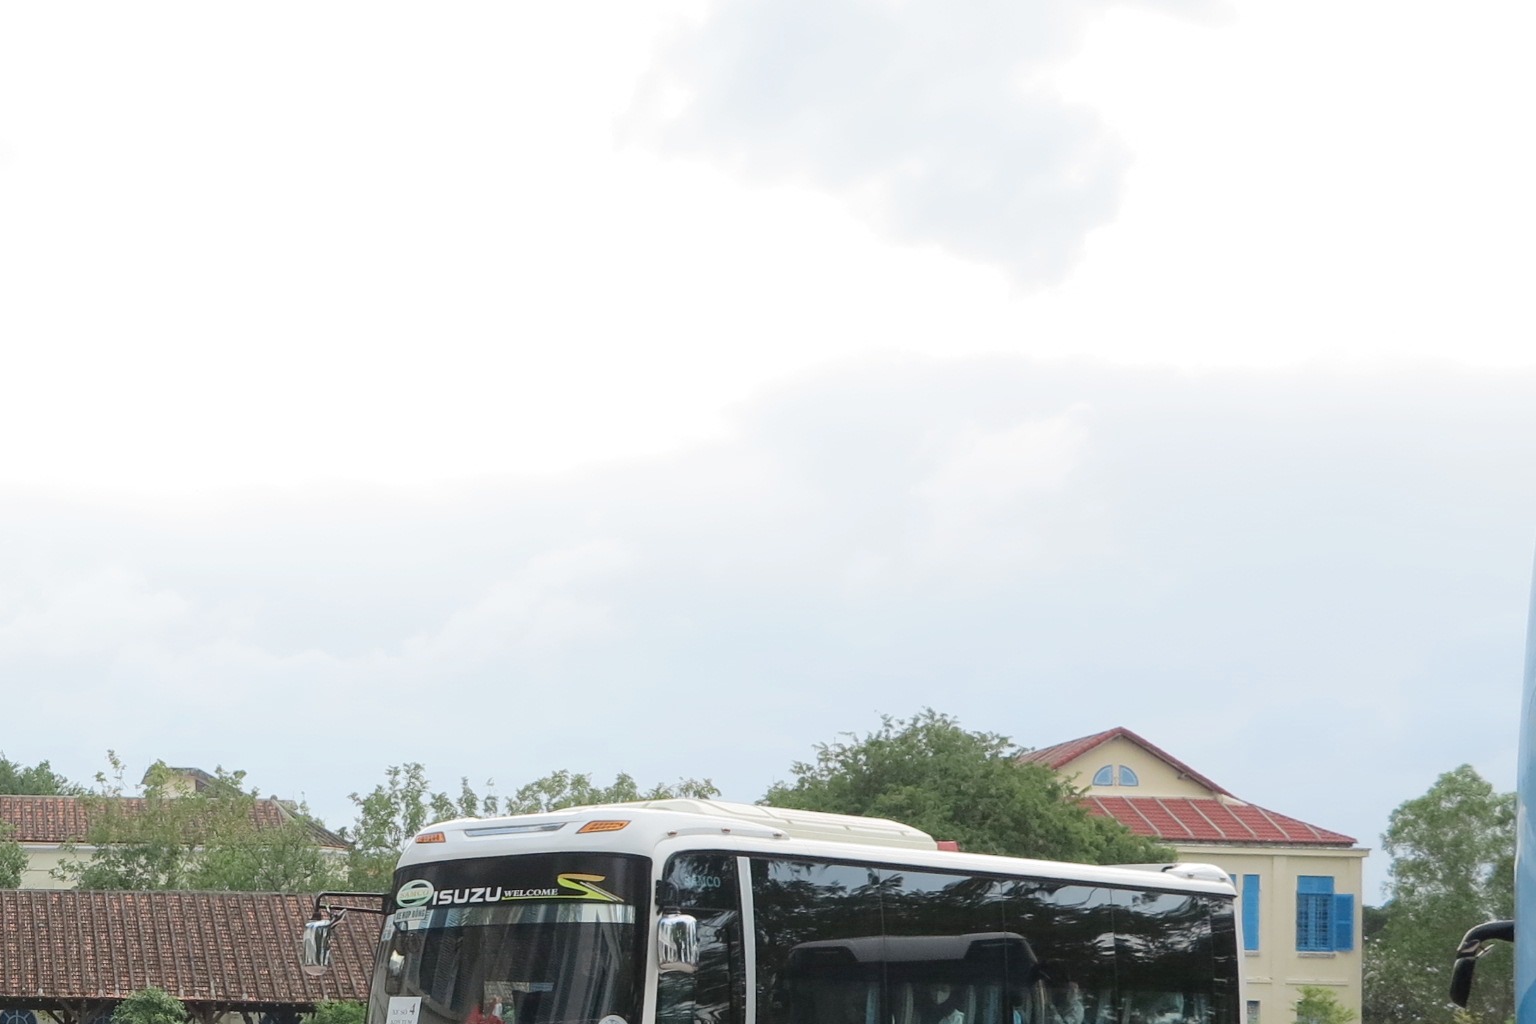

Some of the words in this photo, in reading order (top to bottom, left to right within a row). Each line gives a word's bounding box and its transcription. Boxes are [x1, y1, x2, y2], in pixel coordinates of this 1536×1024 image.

[433, 887, 502, 905] ISUZU
[504, 888, 558, 897] WELCOME
[409, 1003, 416, 1015] 4
